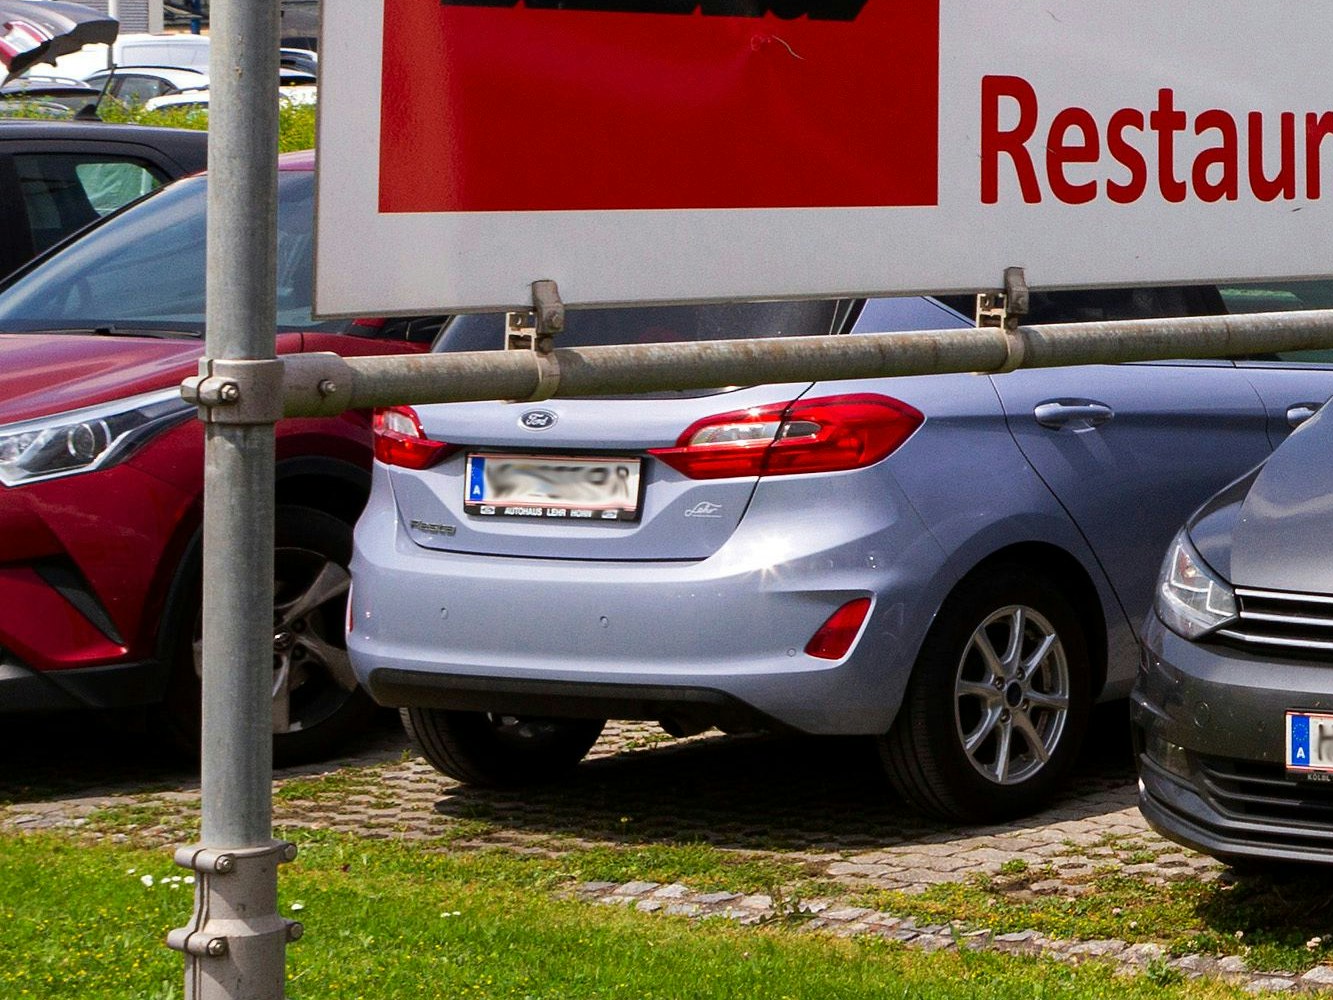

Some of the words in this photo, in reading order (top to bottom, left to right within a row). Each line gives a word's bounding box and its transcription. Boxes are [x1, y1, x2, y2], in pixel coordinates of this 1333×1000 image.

[504, 506, 543, 517] AUTOHAUS
[546, 508, 567, 517] LEHR
[1296, 747, 1306, 759] A
